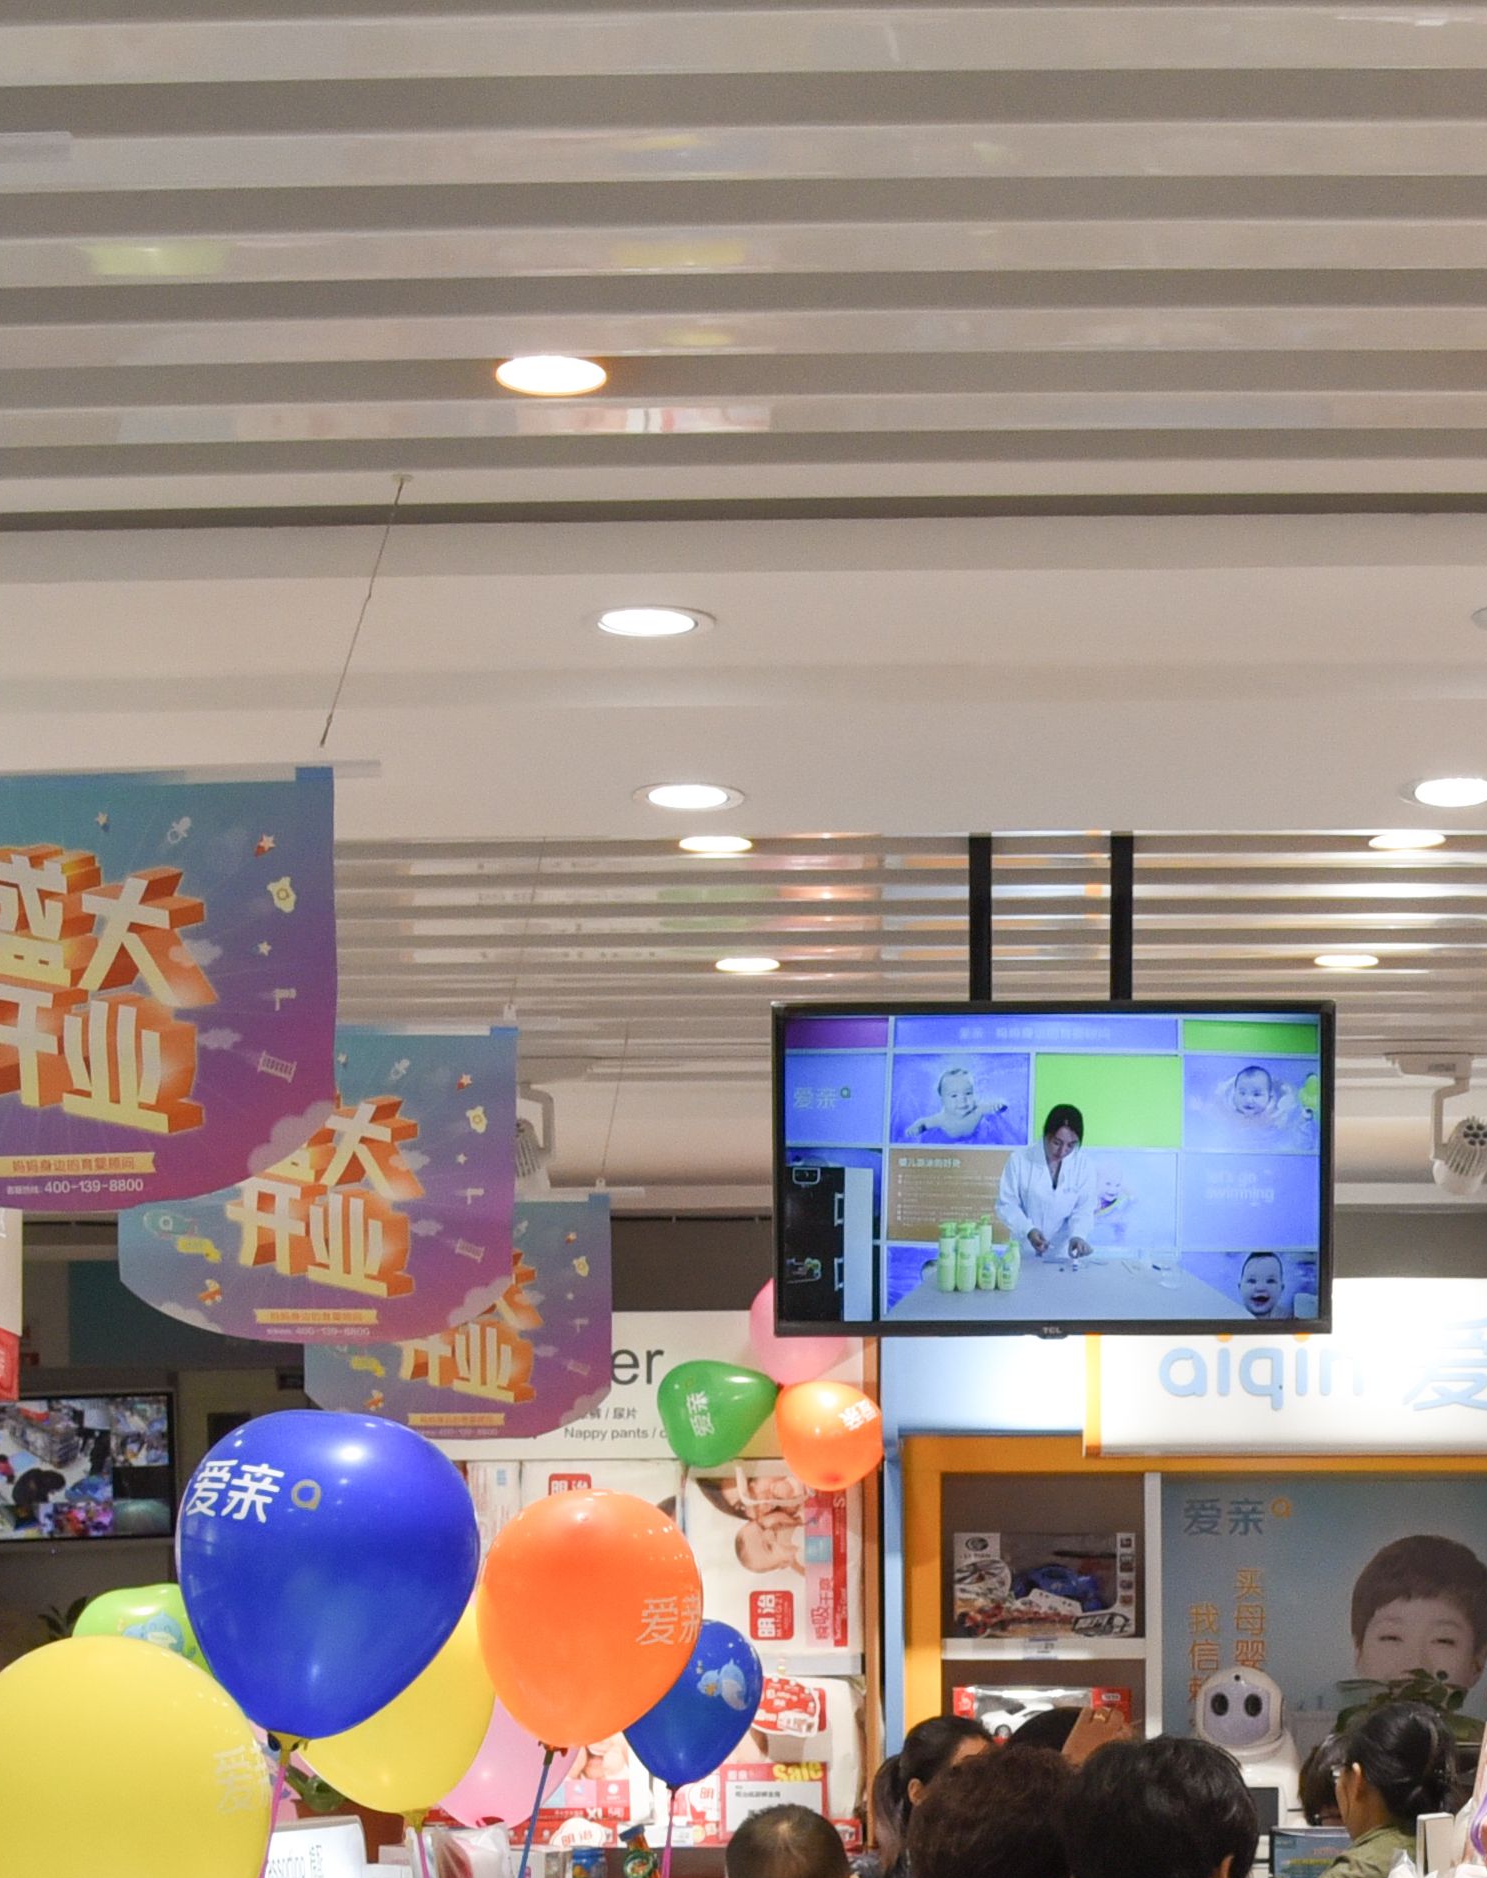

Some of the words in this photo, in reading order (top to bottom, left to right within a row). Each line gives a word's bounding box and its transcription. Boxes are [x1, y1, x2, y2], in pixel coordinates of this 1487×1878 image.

[44, 1179, 144, 1196] 400-139-8800
[226, 1173, 415, 1298] 开业
[1042, 1326, 1062, 1335] TCL
[1158, 1333, 1364, 1413] aiqin
[612, 1405, 638, 1421] 尿片
[609, 1426, 649, 1441] pants
[186, 1455, 284, 1523] 爱亲
[1183, 1496, 1266, 1537] 爱亲
[756, 1594, 776, 1638] 明治
[772, 1762, 824, 1782] Sale
